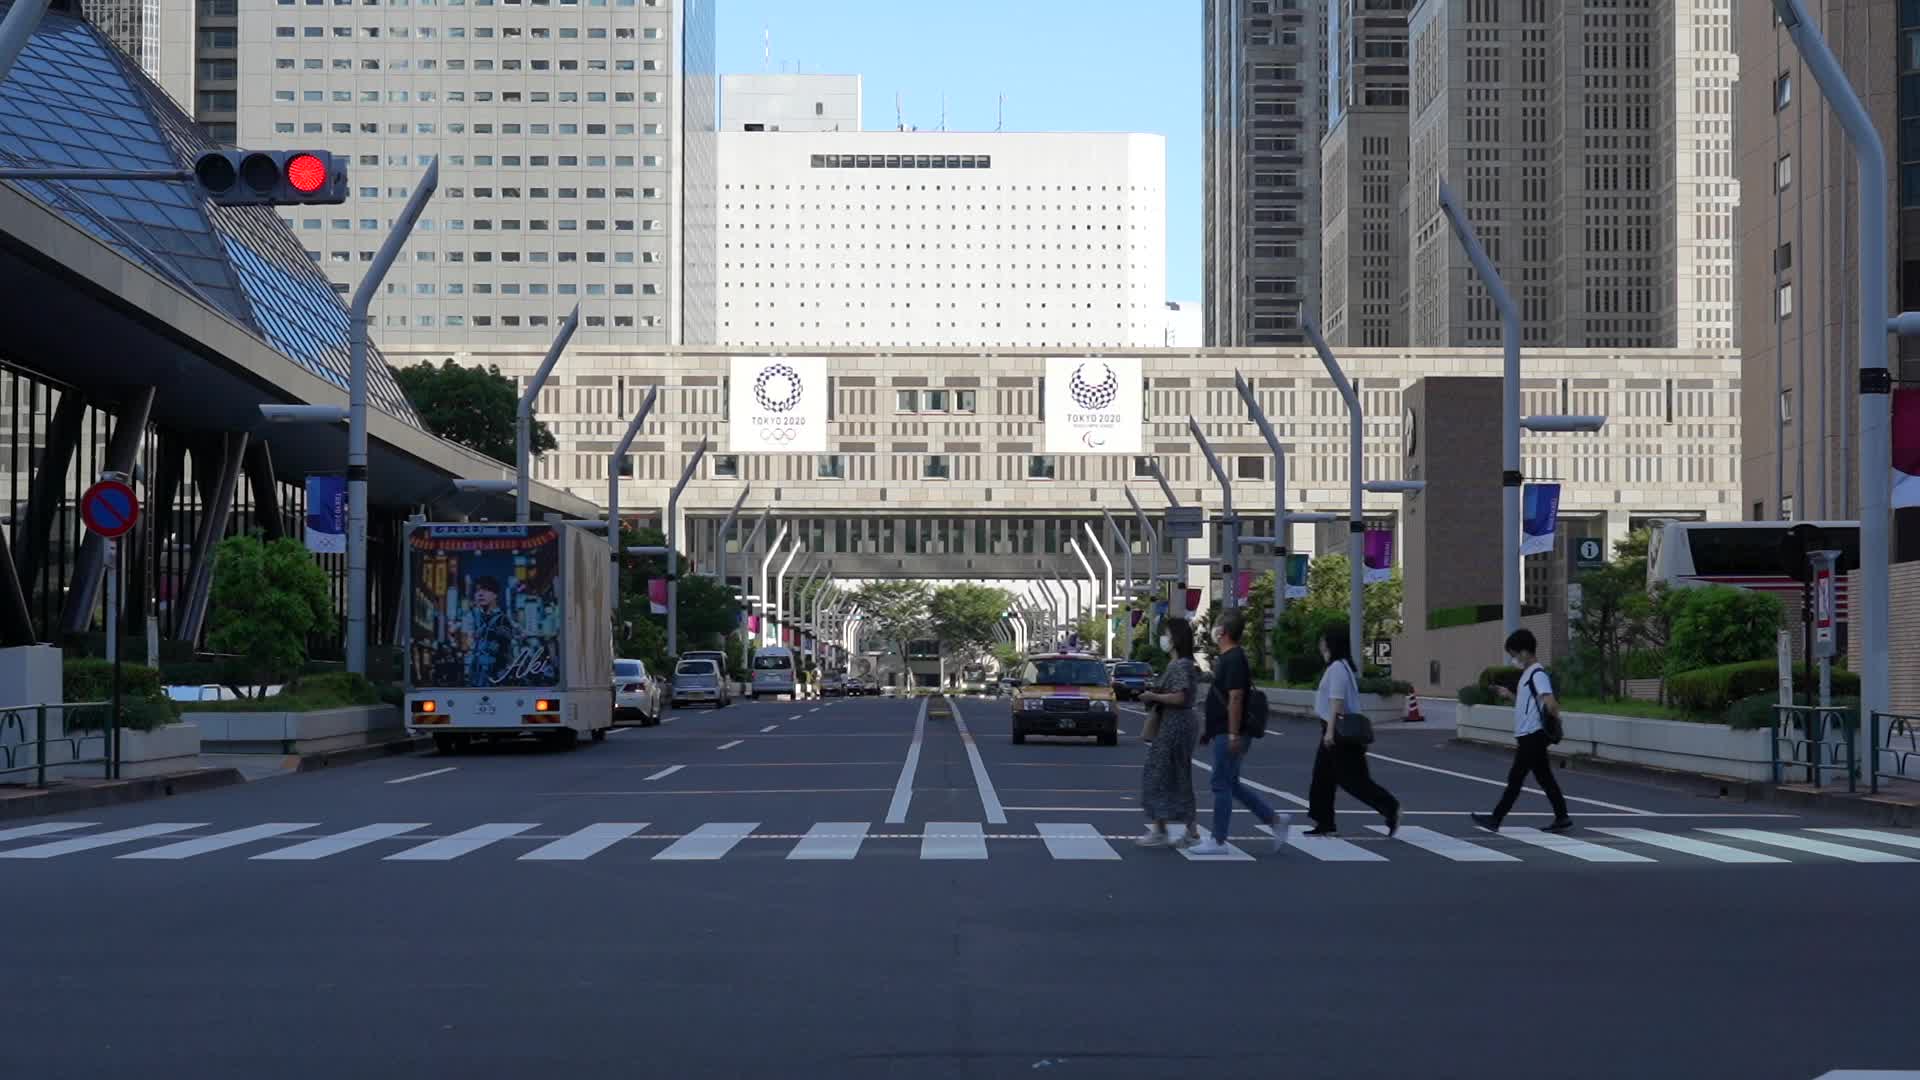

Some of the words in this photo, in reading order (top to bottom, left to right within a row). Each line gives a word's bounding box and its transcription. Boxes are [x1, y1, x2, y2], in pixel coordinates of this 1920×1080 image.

[752, 417, 781, 425] TOKYO
[783, 417, 806, 425] 2020
[1067, 414, 1097, 422] TOKYO
[1099, 414, 1121, 422] 2020
[1379, 643, 1390, 656] P
[488, 647, 551, 684] Aki
